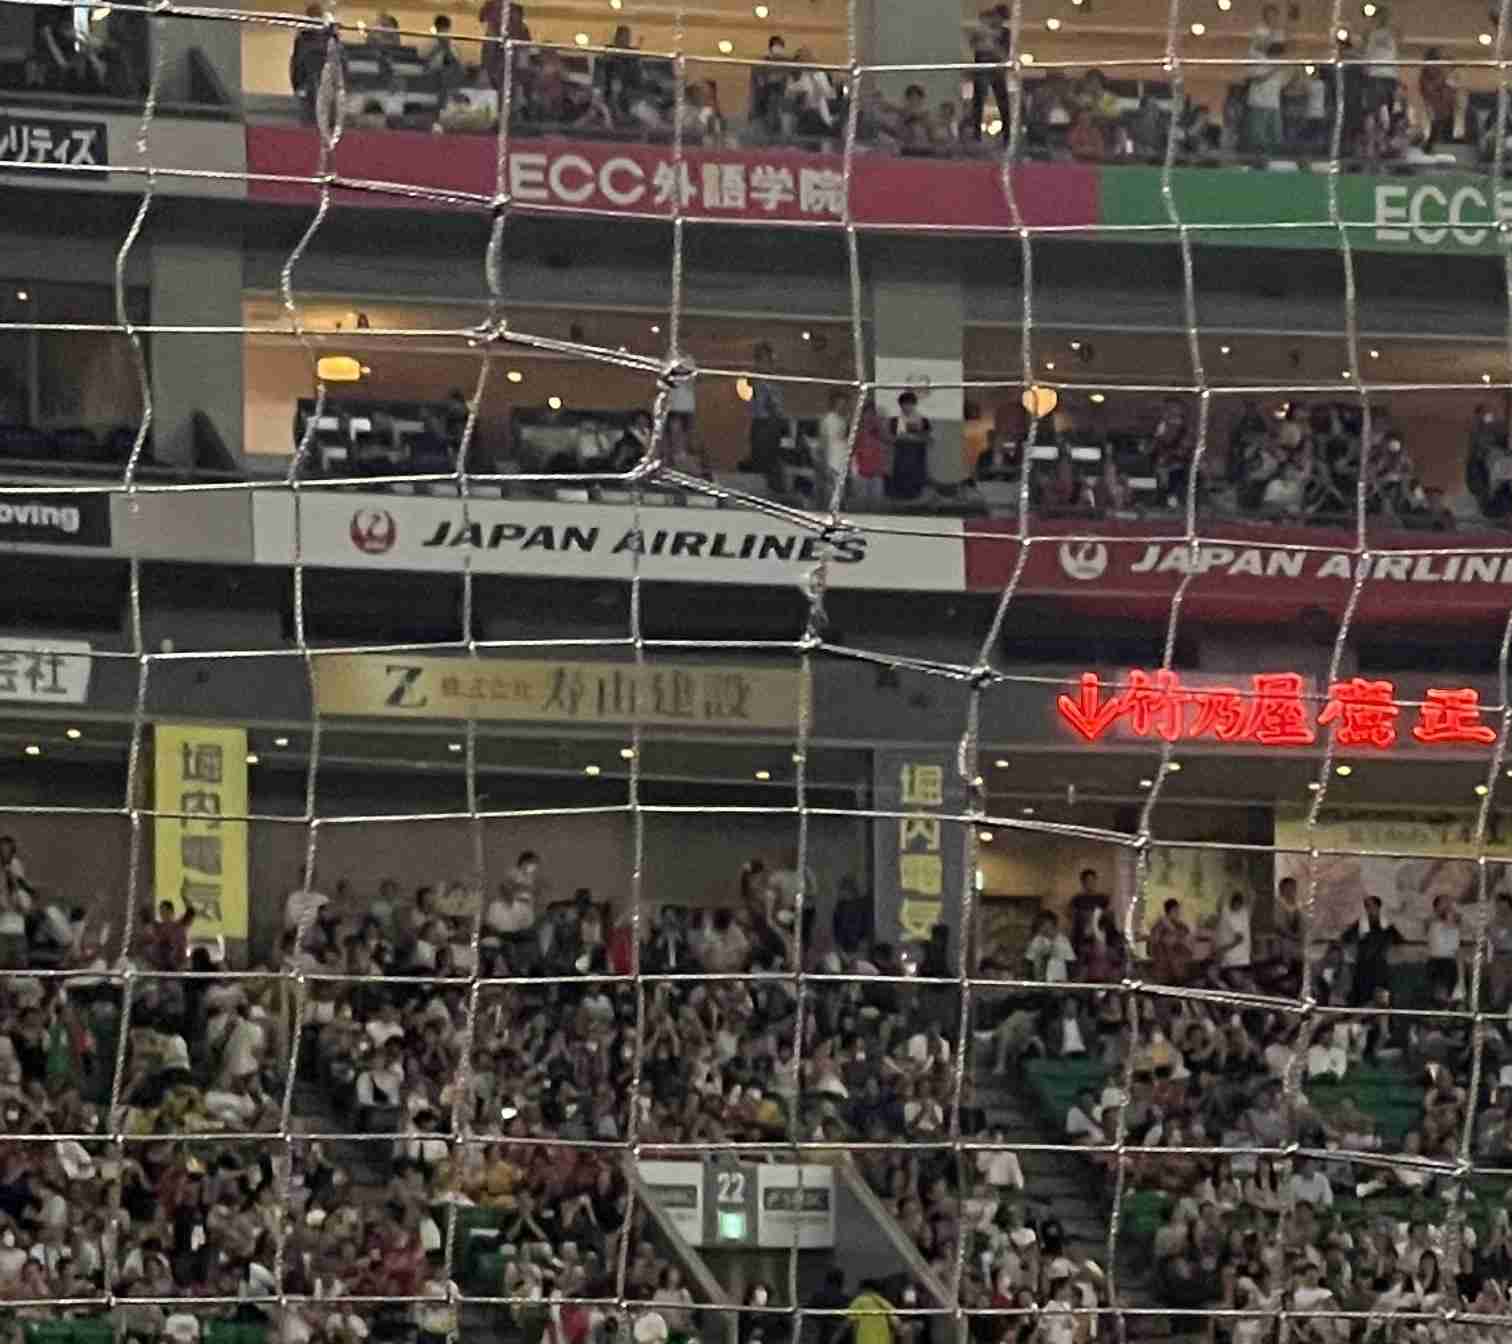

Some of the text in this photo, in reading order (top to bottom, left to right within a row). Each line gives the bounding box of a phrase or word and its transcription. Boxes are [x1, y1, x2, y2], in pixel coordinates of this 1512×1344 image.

[509, 153, 848, 212] ECC外語学院
[423, 520, 868, 564] JAPAN AIRLINES
[1131, 543, 1303, 577] JAPAN
[716, 1171, 746, 1204] 22
